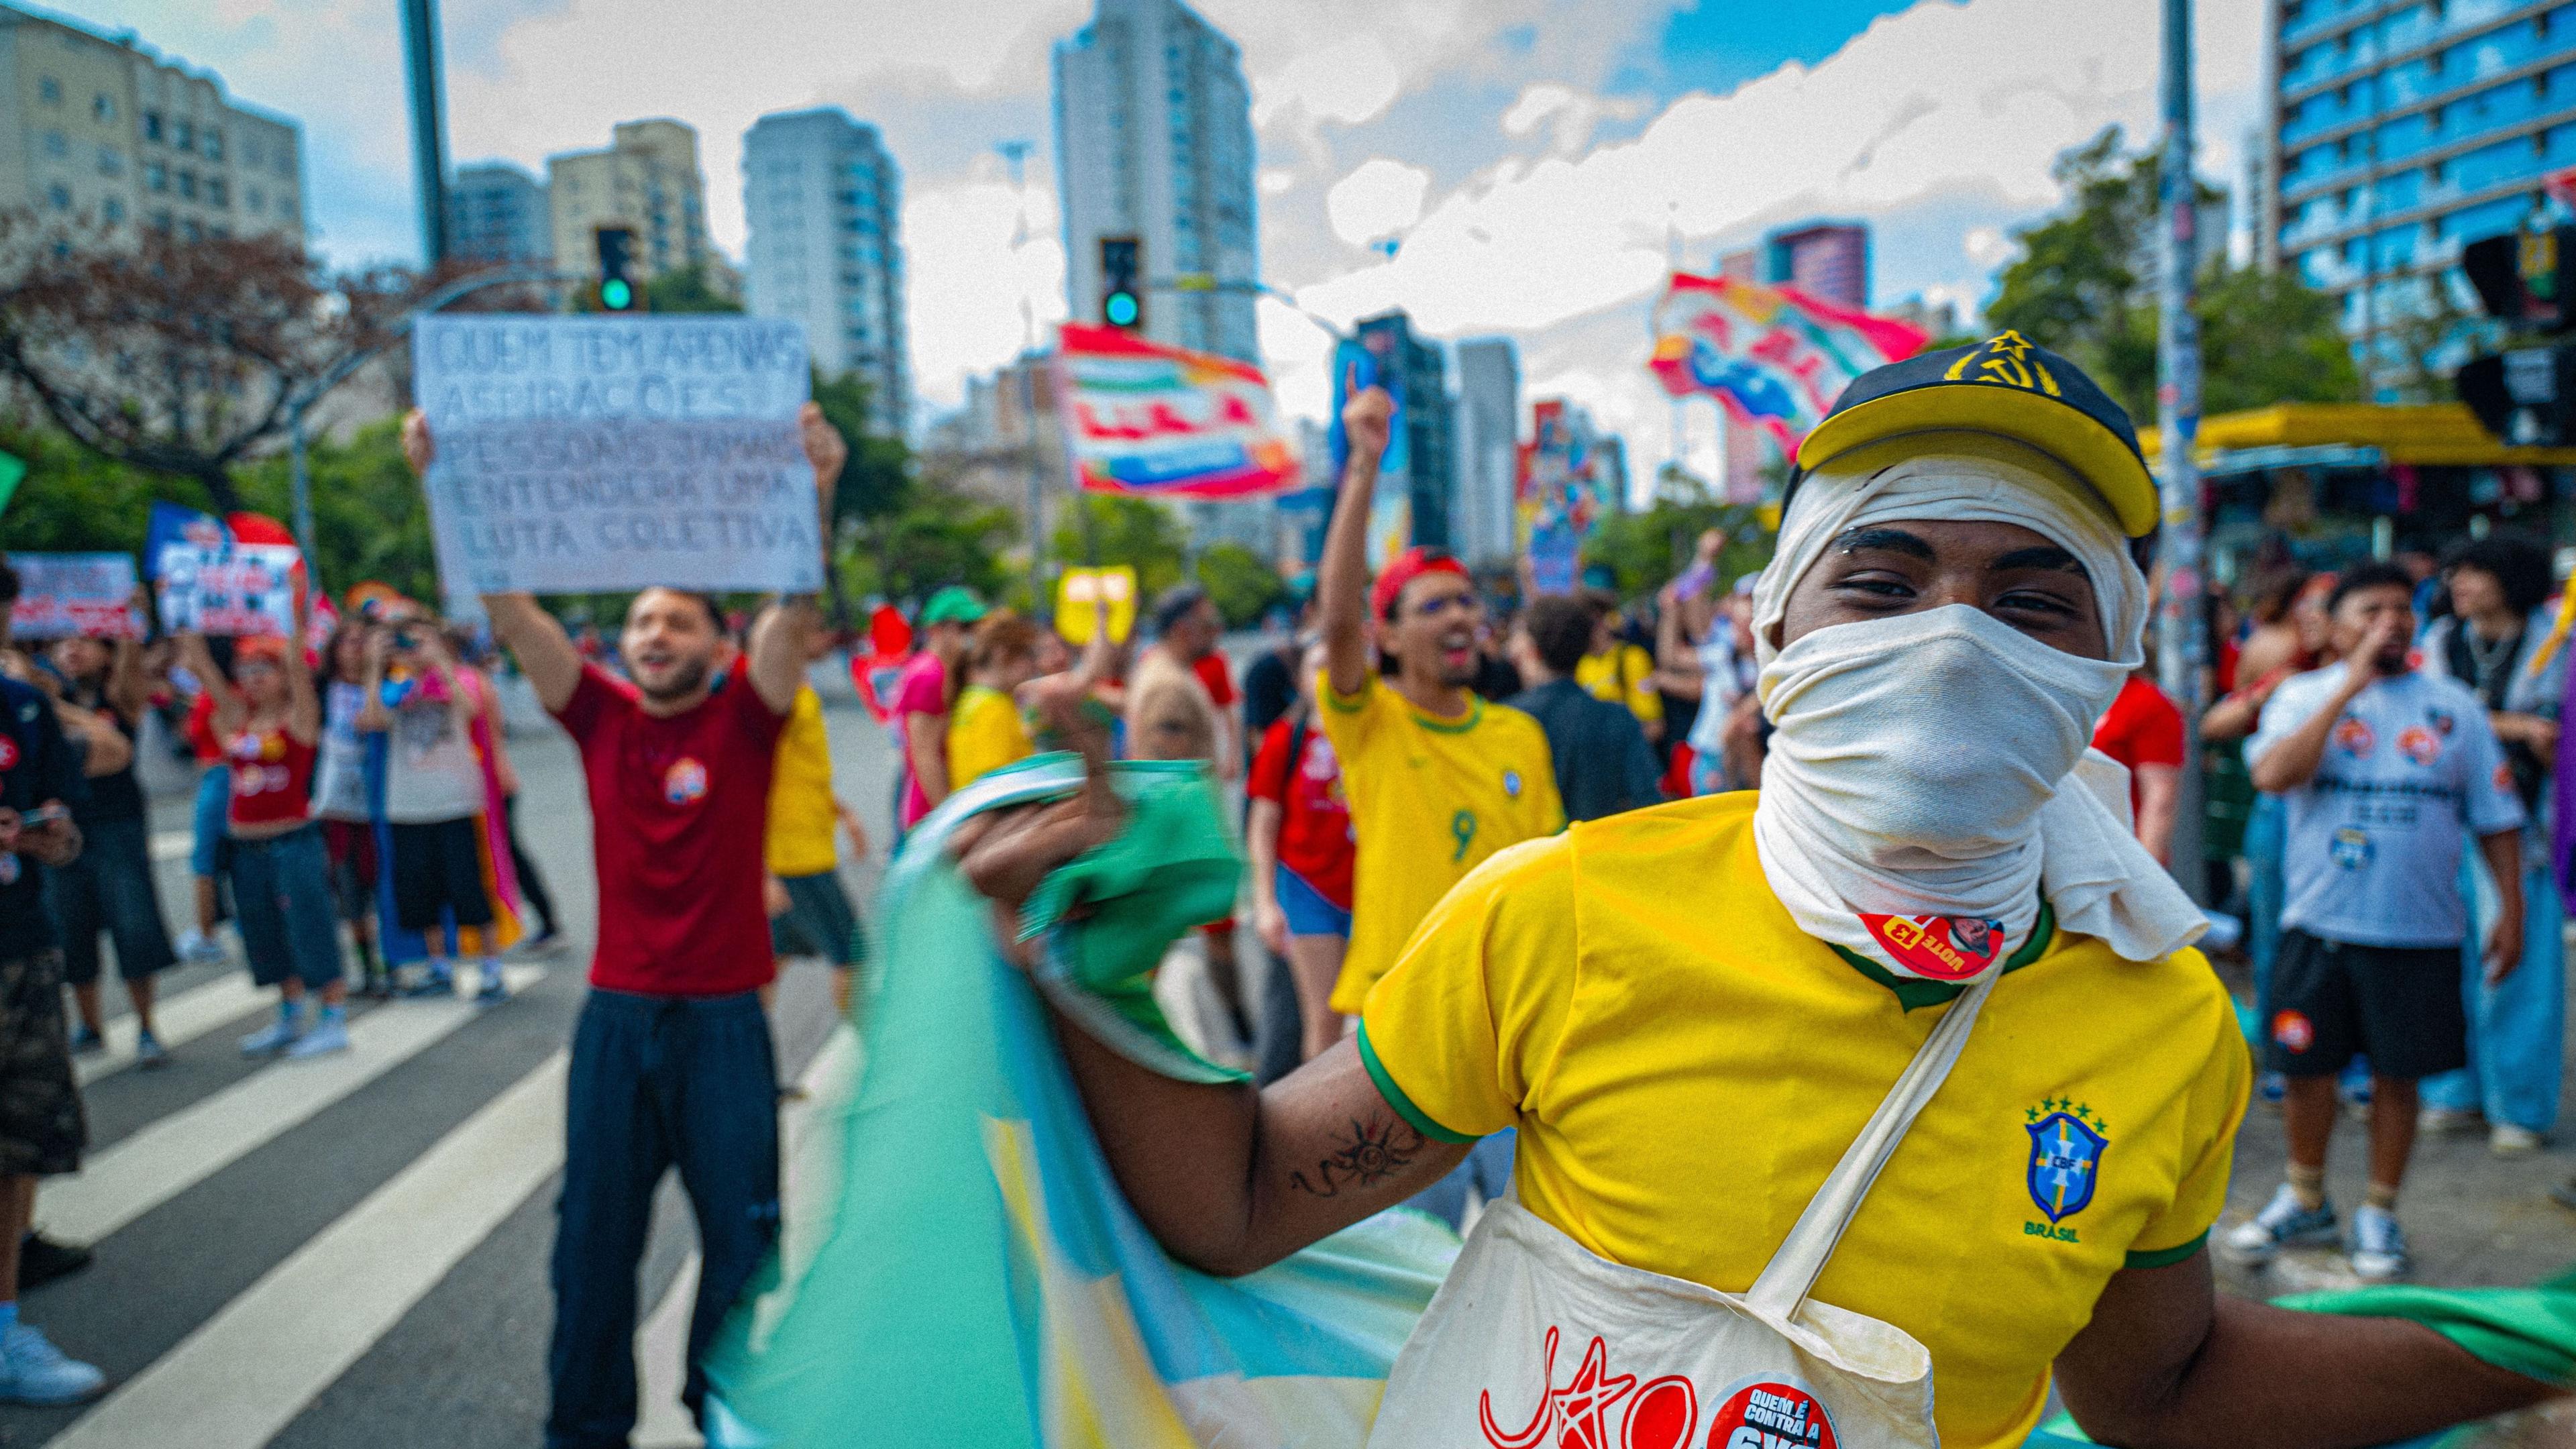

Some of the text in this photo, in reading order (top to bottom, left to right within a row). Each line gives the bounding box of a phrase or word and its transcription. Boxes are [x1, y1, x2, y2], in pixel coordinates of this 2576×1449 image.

[433, 323, 802, 374] QUEM TEM APENAS
[714, 470, 796, 504] UMA
[462, 511, 810, 559] LUTA COLETIVA
[1452, 808, 1477, 863] 9
[1890, 923, 1966, 972] VOTE 13
[2051, 1155, 2077, 1170] CBF
[2023, 1220, 2081, 1243] BRASIL
[1744, 1403, 1806, 1437] CONTRA
[1807, 1422, 1820, 1440] A
[1750, 1389, 1809, 1419] QUEM É
